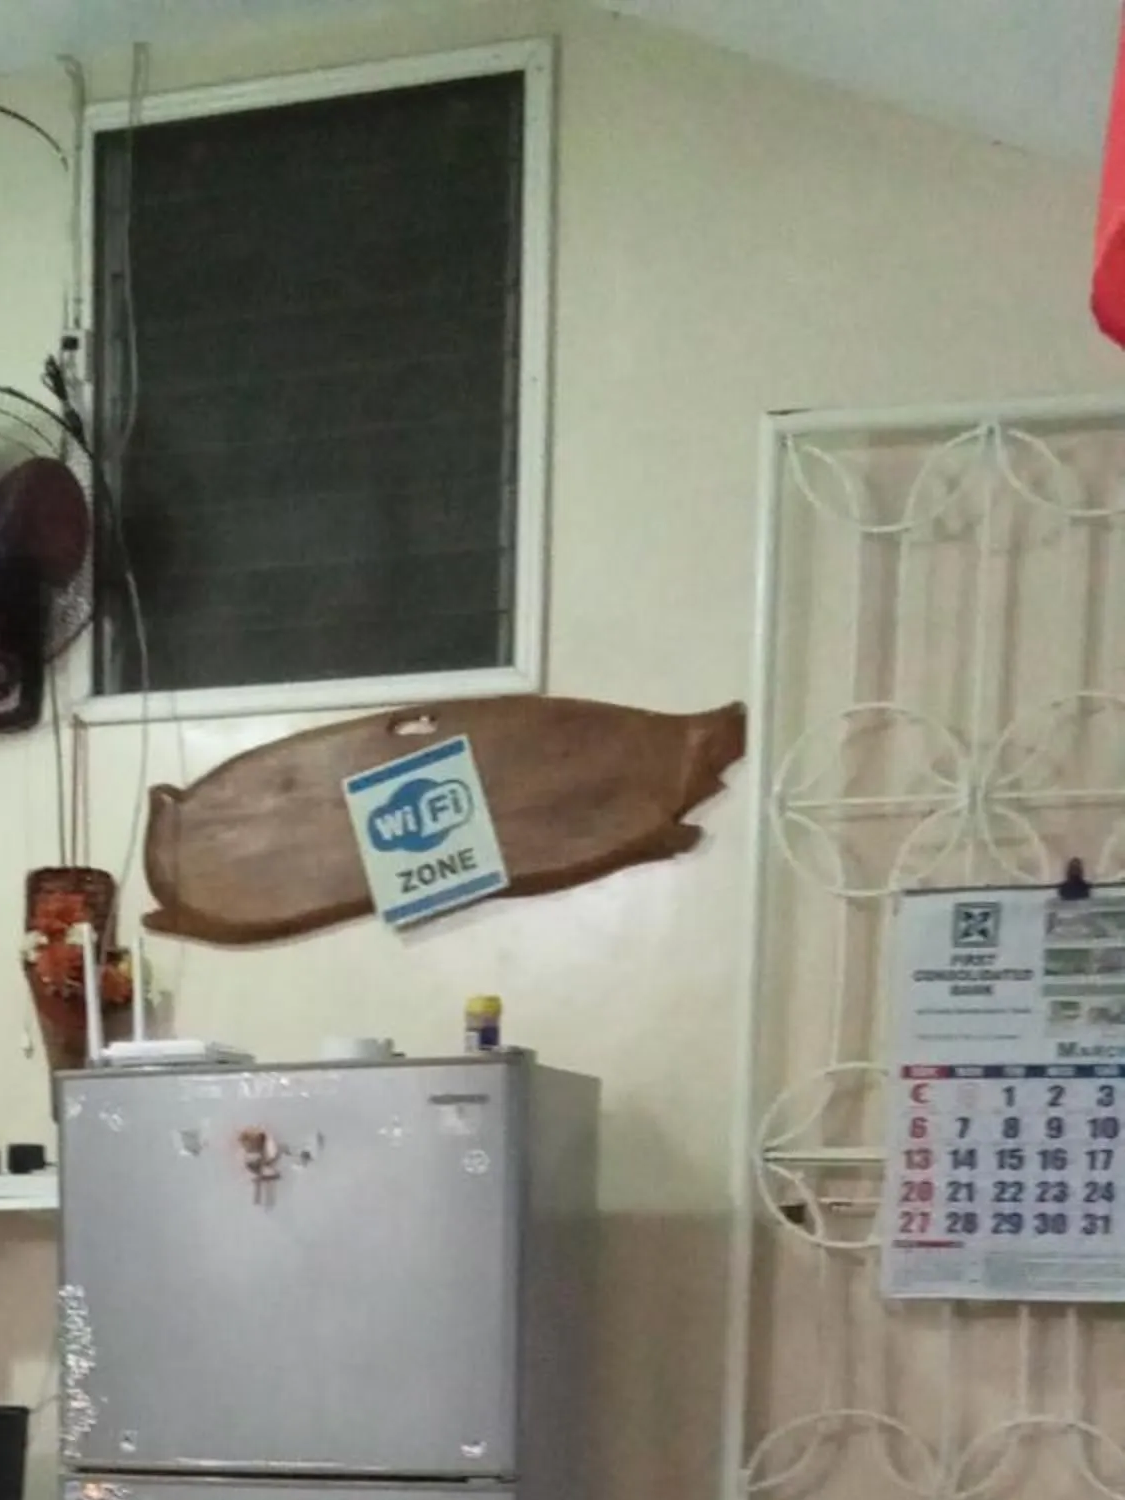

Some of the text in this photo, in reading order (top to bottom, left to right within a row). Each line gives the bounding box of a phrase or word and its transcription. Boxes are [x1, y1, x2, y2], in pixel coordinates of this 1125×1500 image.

[394, 847, 479, 894] ZONE
[1002, 1085, 1115, 1107] 1 2 3
[909, 1116, 1120, 1139] 6 7 8 9 10
[903, 1148, 1114, 1171] 13 14 15 16 17
[900, 1180, 1115, 1203] 20 21 22 23 24
[898, 1211, 1112, 1235] 27 28 29 30 31
